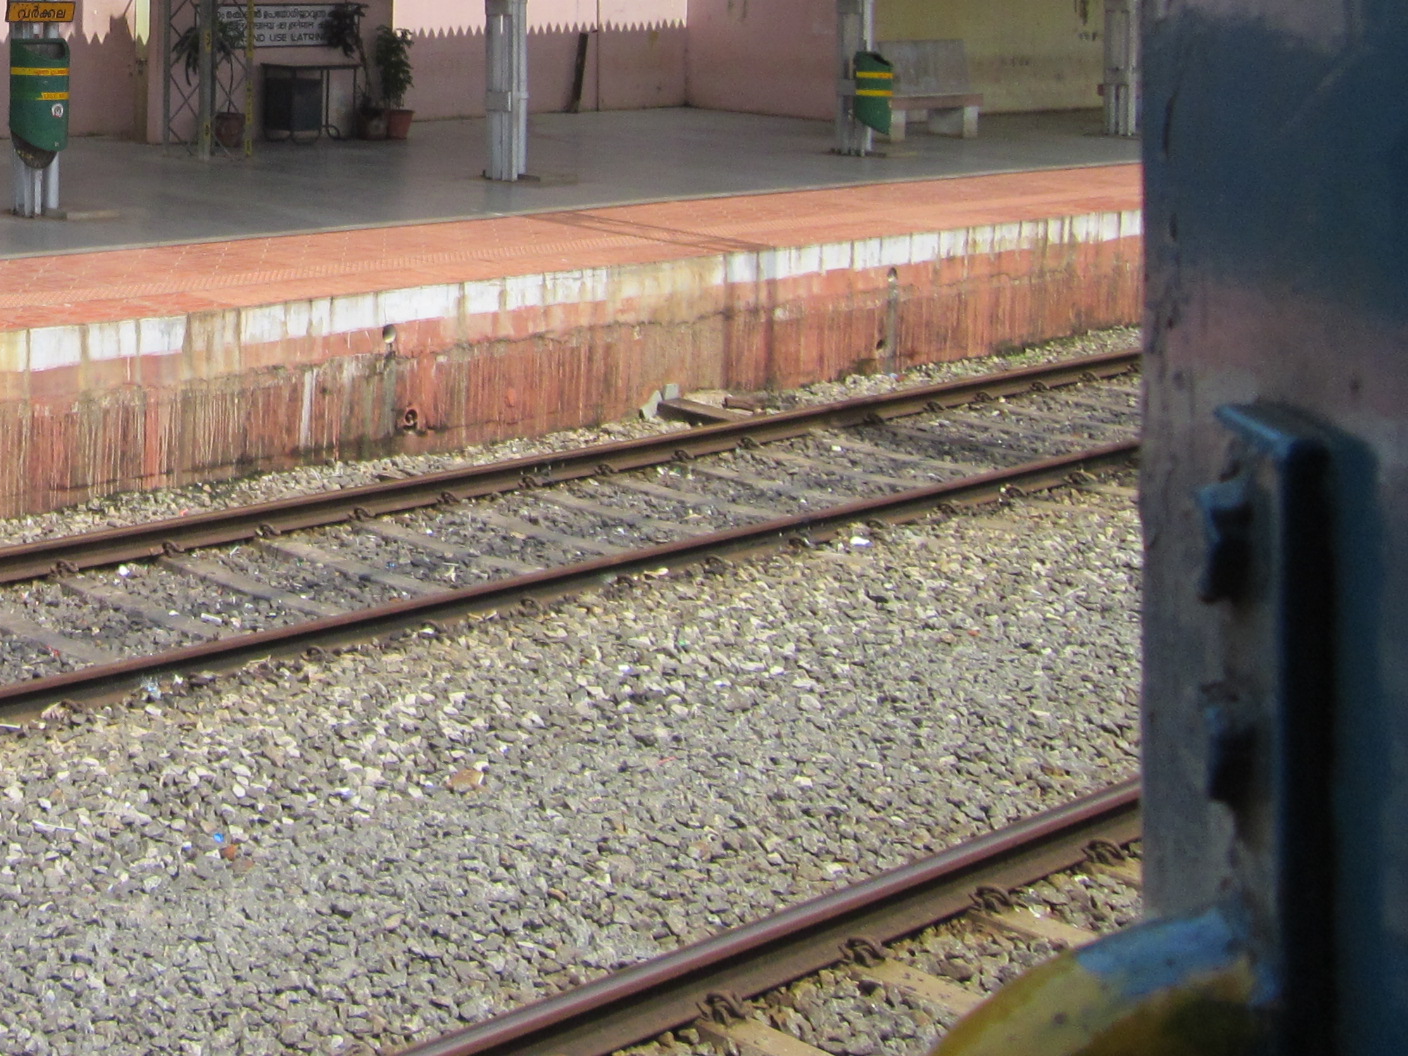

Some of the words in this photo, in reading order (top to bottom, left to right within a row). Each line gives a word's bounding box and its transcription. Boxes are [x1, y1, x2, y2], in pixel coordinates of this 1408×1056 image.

[17, 5, 66, 19] വർക്കല
[269, 33, 287, 42] USE
[290, 32, 328, 42] LATRIN
